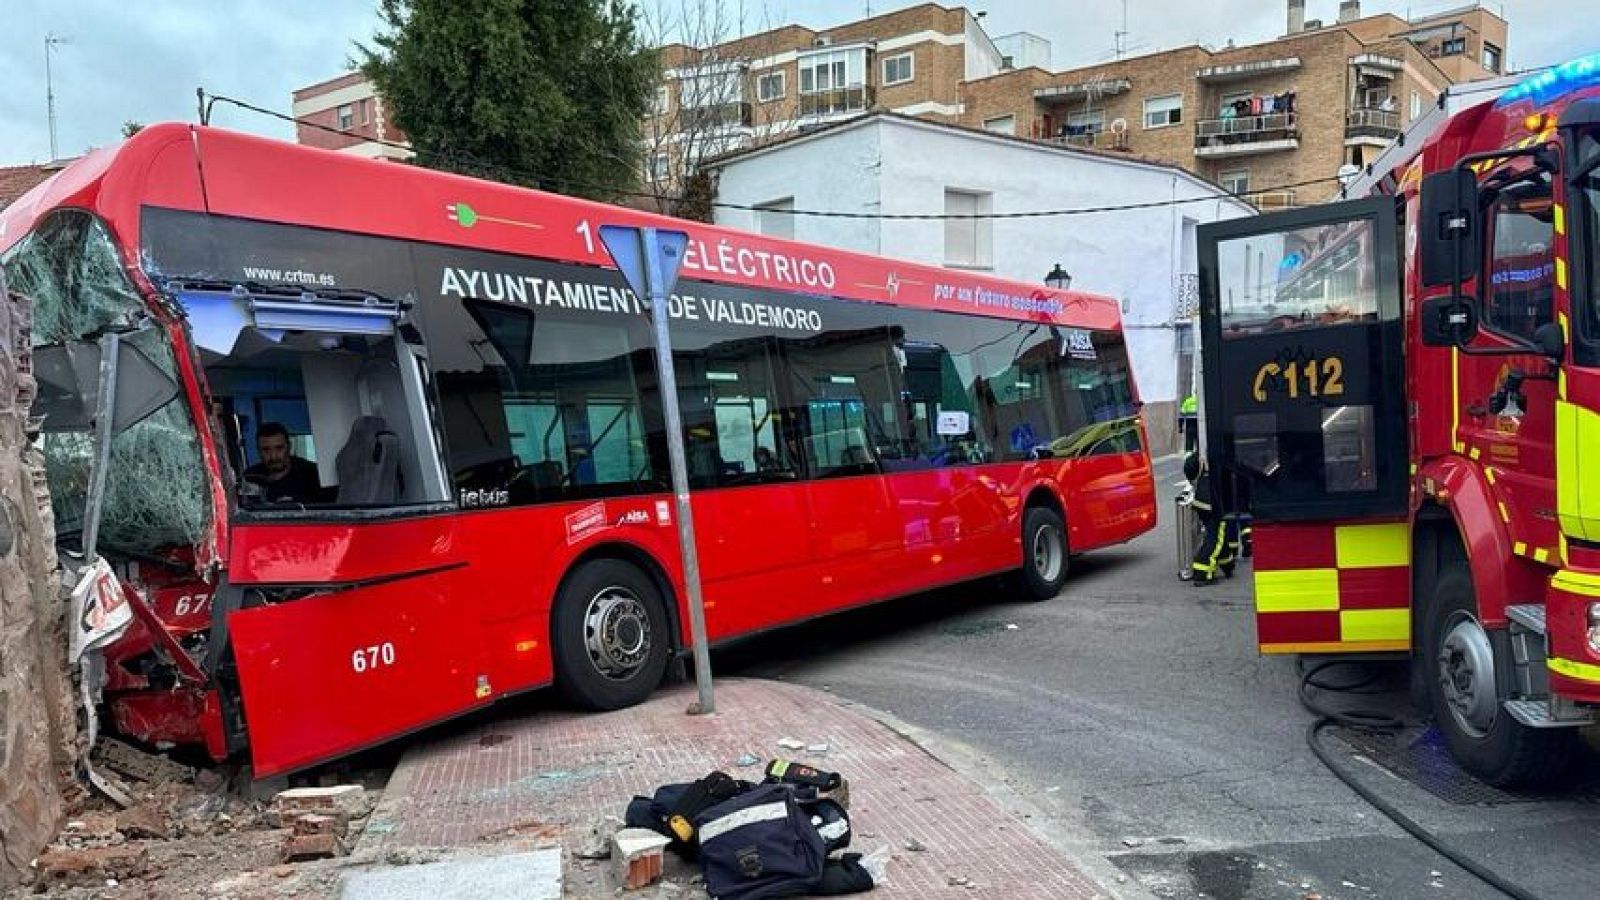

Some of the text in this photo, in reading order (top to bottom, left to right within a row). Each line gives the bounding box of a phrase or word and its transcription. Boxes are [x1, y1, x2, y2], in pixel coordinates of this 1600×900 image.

[243, 266, 336, 286] www.crtm.es
[683, 238, 836, 290] ELÉCTRICO
[440, 266, 822, 331] AYUNTAMIENT DE VALDEMORO
[934, 284, 956, 301] por
[1283, 356, 1344, 398] 112
[175, 594, 215, 616] 67
[352, 642, 395, 672] 670
